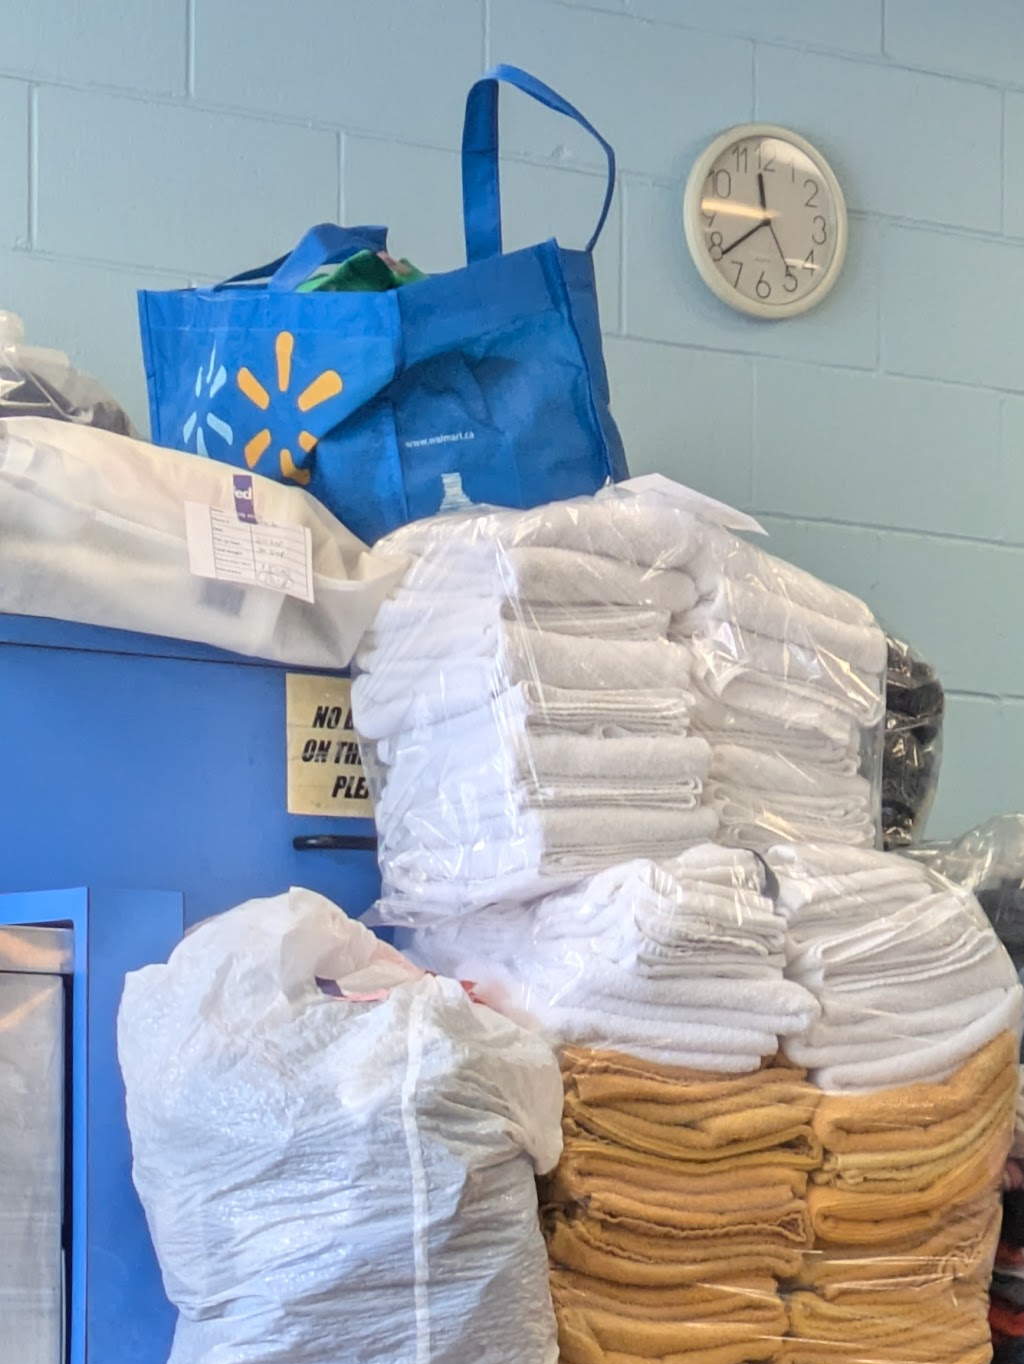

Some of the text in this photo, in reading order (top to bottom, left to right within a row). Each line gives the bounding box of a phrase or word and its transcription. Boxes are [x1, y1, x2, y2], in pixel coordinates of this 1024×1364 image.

[732, 146, 748, 174] 11
[755, 142, 777, 173] 12
[787, 156, 795, 183] 1
[707, 169, 731, 199] 10
[803, 178, 819, 208] 2
[811, 215, 827, 245] 3
[709, 231, 724, 262] 8
[731, 261, 743, 289] 7
[802, 249, 819, 277] 4
[756, 270, 771, 299] 6
[783, 265, 798, 293] 5
[312, 705, 342, 729] NO
[302, 739, 331, 763] ON
